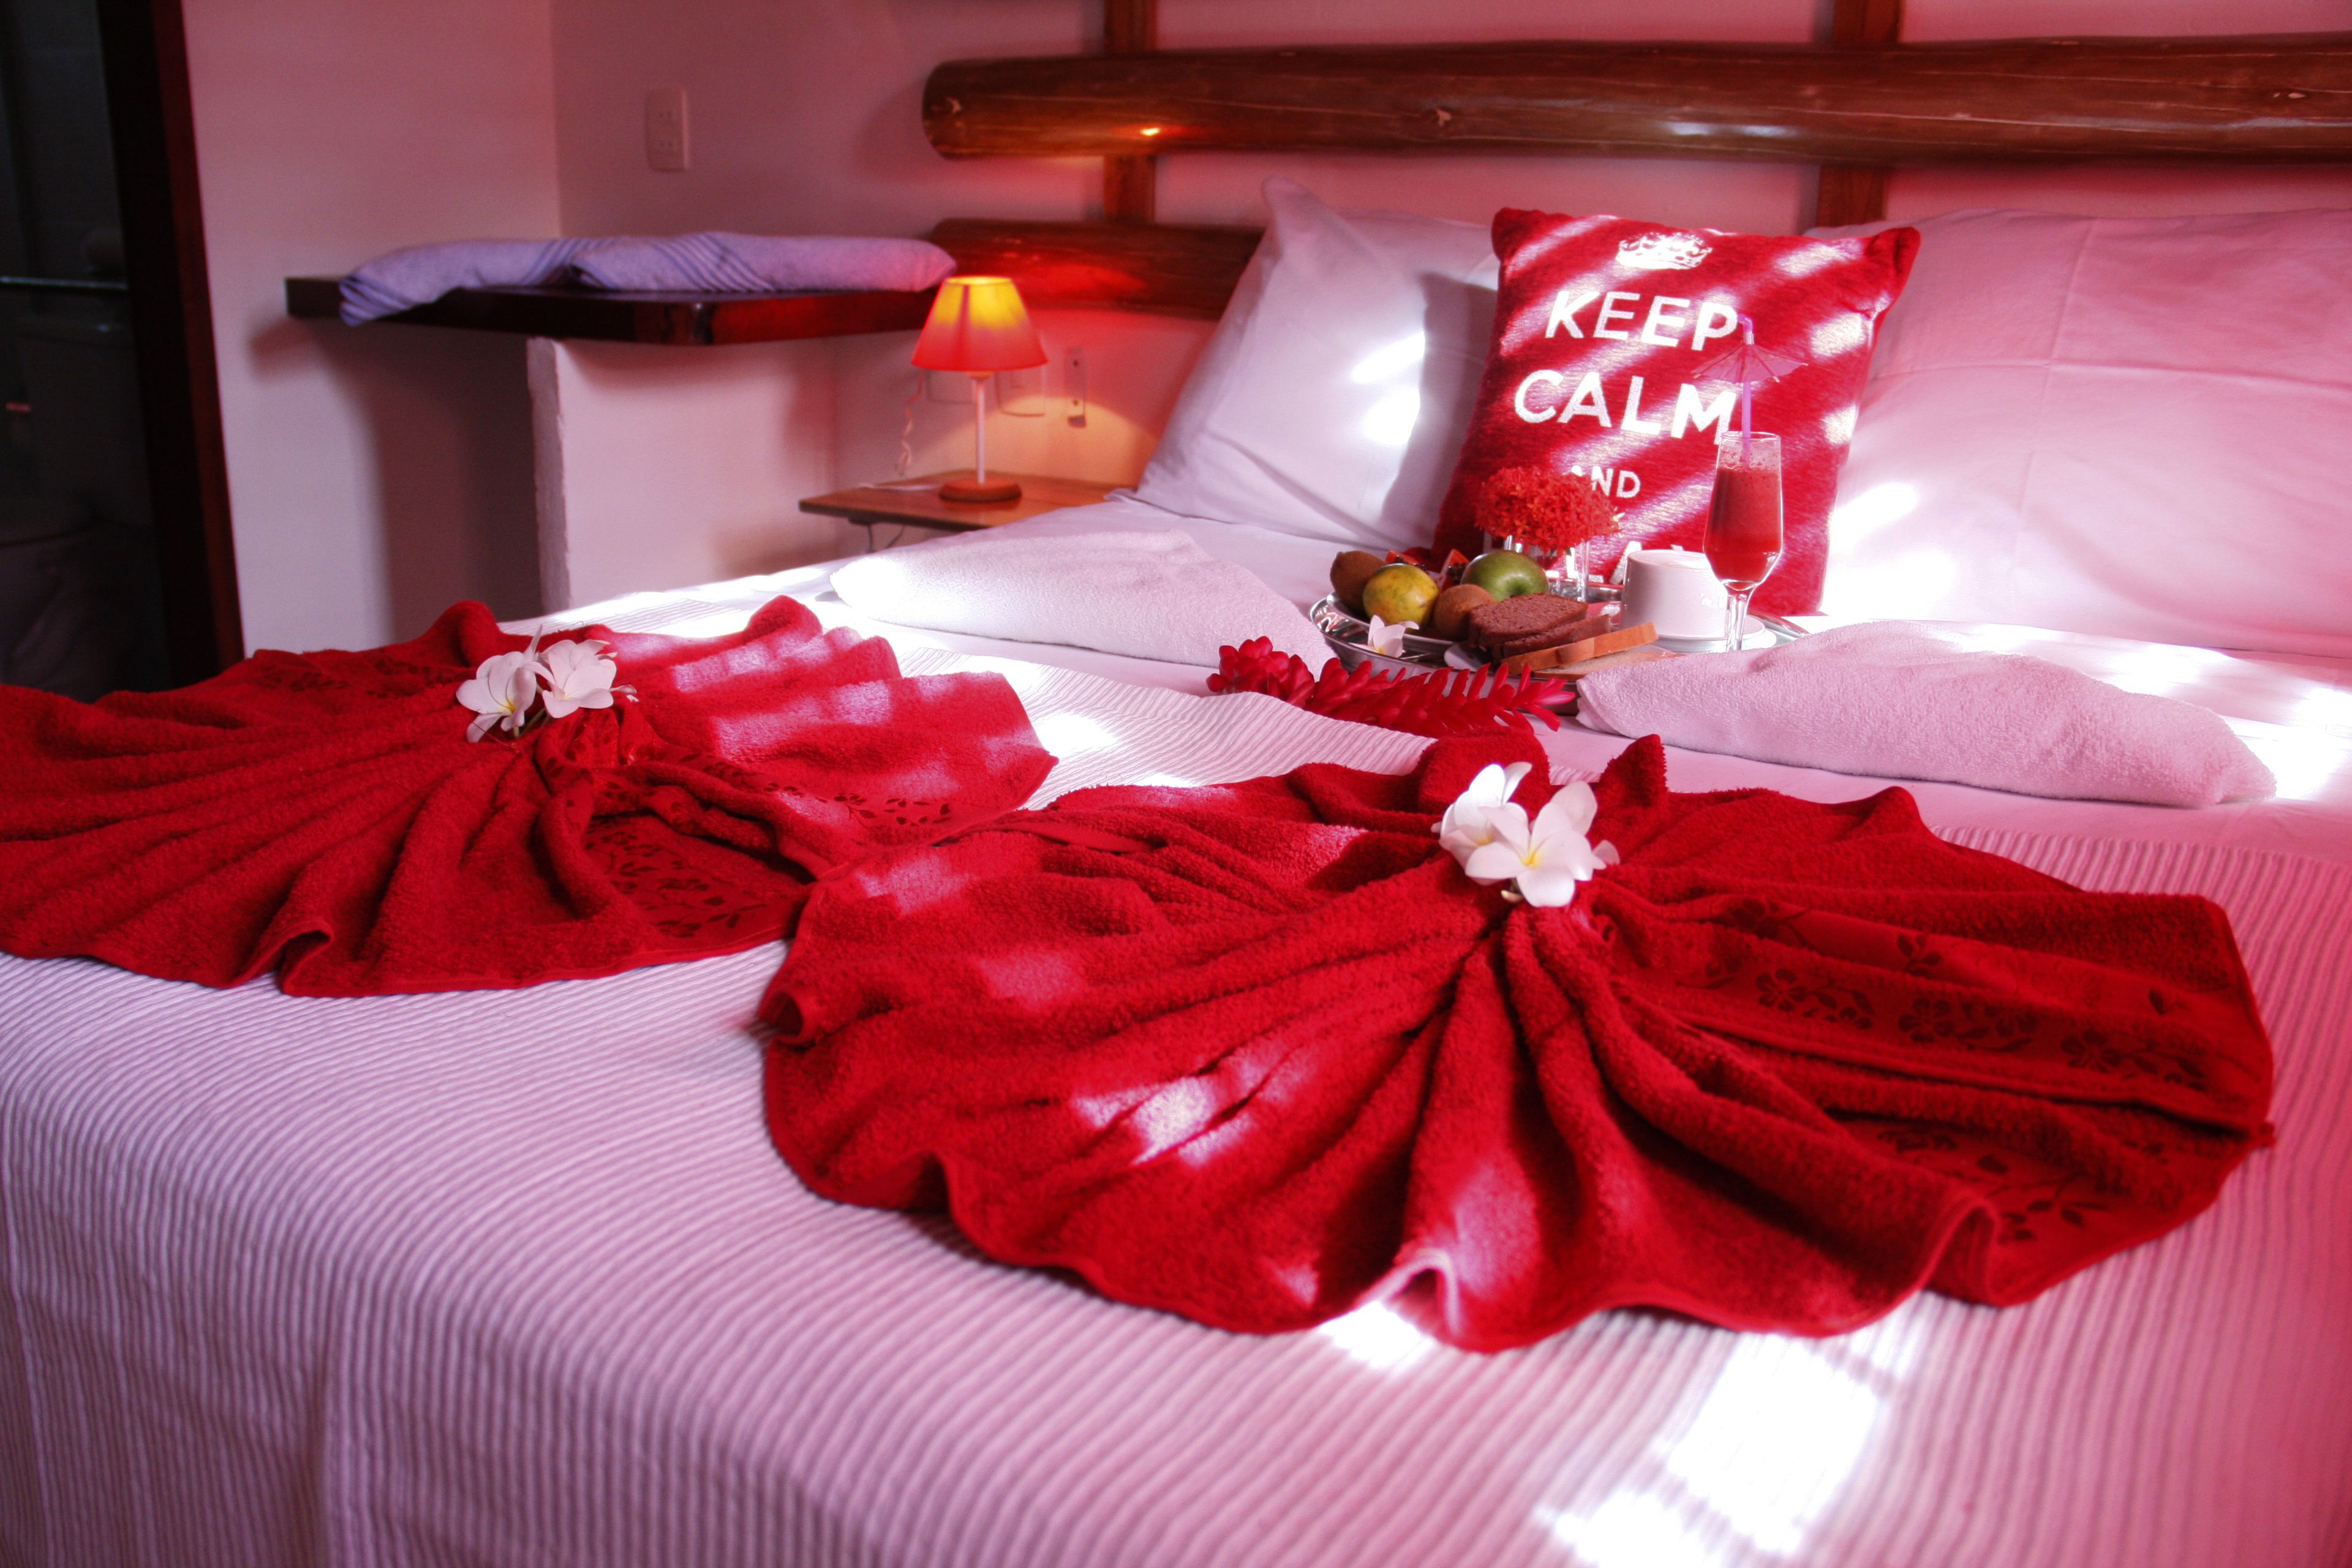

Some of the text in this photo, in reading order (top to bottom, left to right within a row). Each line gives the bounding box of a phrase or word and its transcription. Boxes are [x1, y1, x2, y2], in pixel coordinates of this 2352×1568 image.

[1545, 290, 1738, 352] KEEP
[1514, 369, 1737, 445] CALM
[1569, 464, 1642, 499] ND
